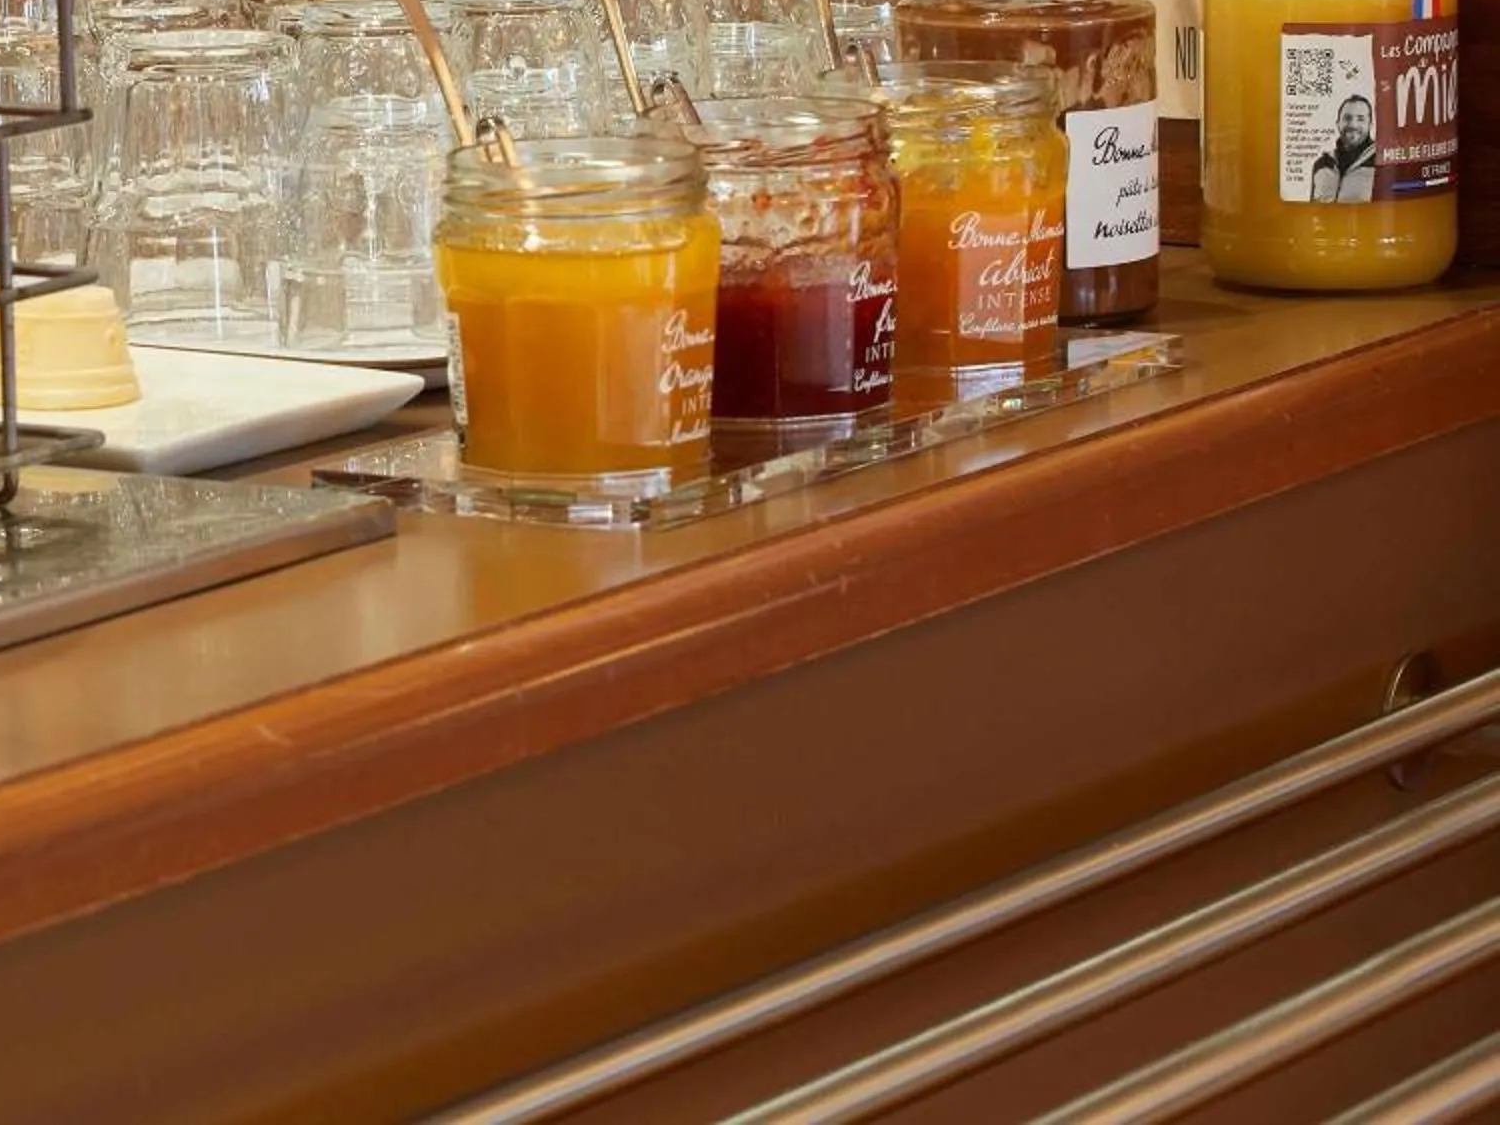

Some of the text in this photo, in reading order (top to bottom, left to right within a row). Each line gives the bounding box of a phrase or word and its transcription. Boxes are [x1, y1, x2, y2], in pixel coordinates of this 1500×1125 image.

[1091, 126, 1146, 166] Bonne
[947, 210, 1020, 250] Bonne
[978, 286, 1052, 310] INTENSE
